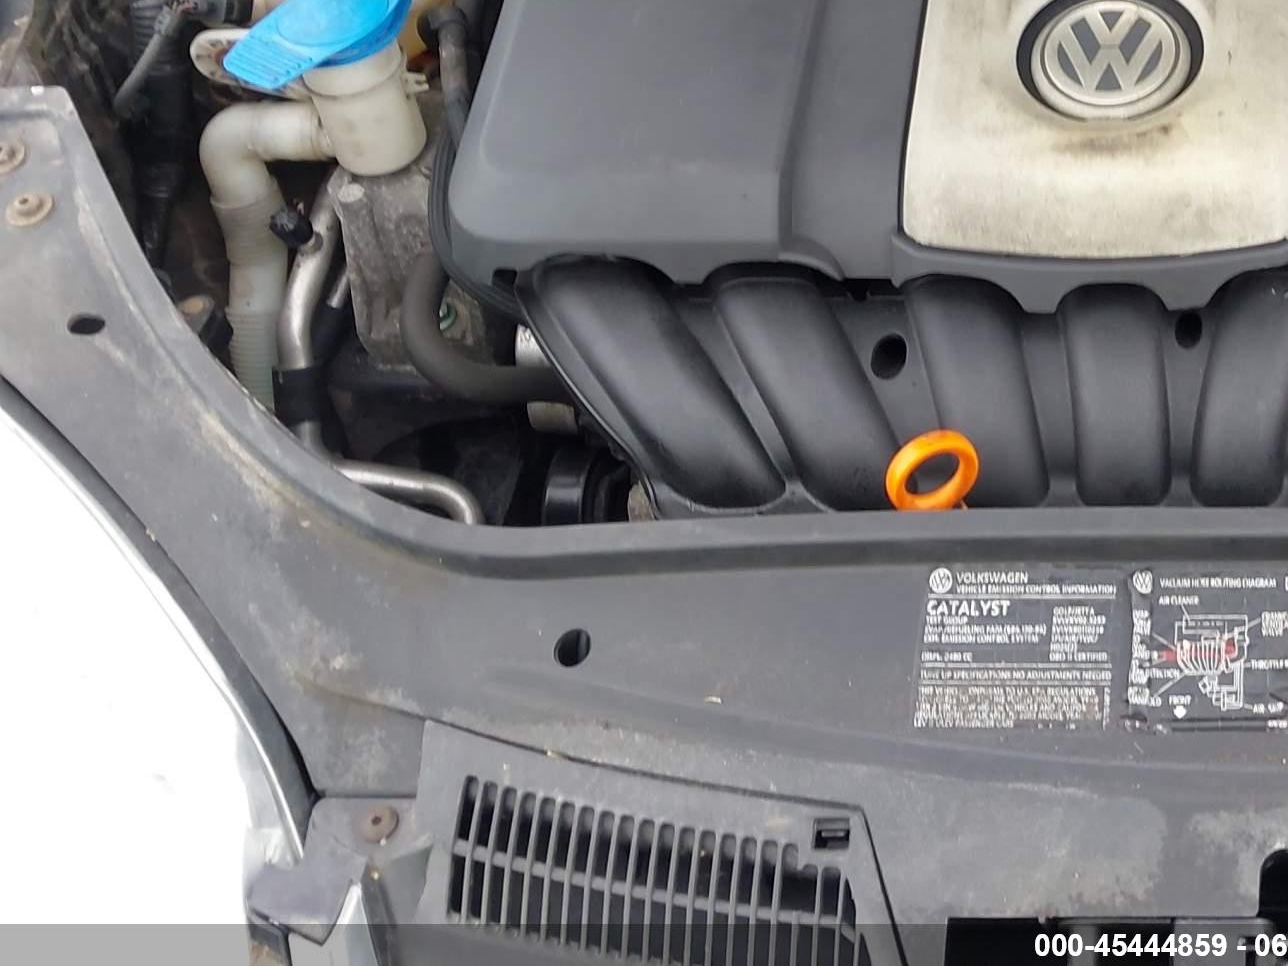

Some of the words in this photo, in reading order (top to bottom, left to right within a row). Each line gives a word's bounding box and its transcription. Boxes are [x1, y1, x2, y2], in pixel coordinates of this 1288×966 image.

[956, 572, 1029, 584] VOLKSWAGEN
[1159, 596, 1170, 605] AIR
[927, 600, 1010, 616] CATALYST
